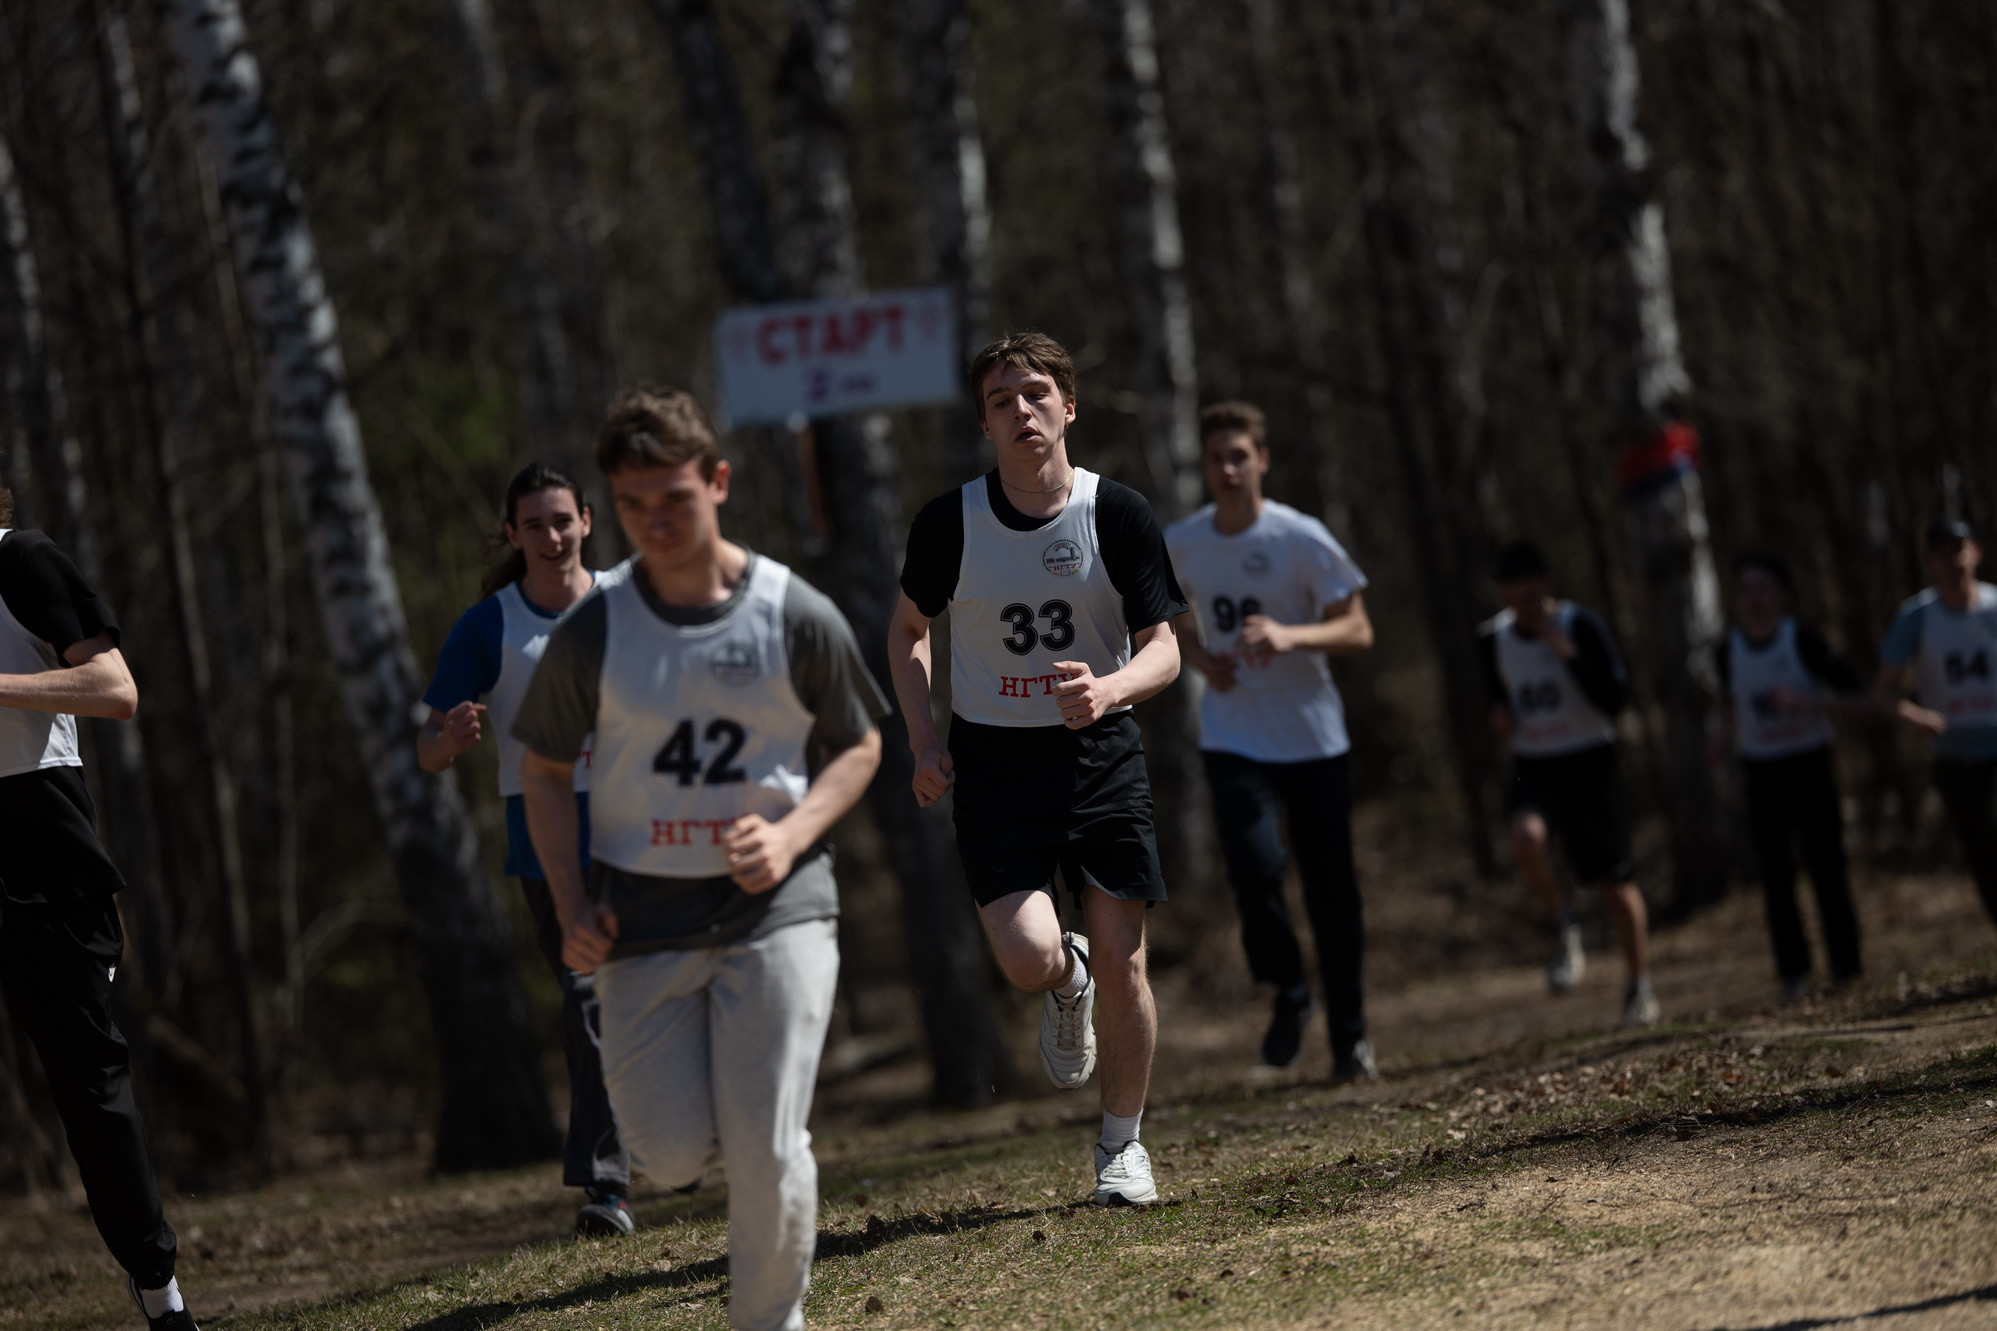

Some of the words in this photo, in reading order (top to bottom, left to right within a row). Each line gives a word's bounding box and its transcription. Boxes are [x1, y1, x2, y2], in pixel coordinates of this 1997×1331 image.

[755, 305, 906, 366] СТАРТ
[1053, 563, 1077, 571] НГТУ
[1000, 599, 1075, 656] 33
[653, 718, 747, 785] 42
[651, 818, 740, 846] НГТ
